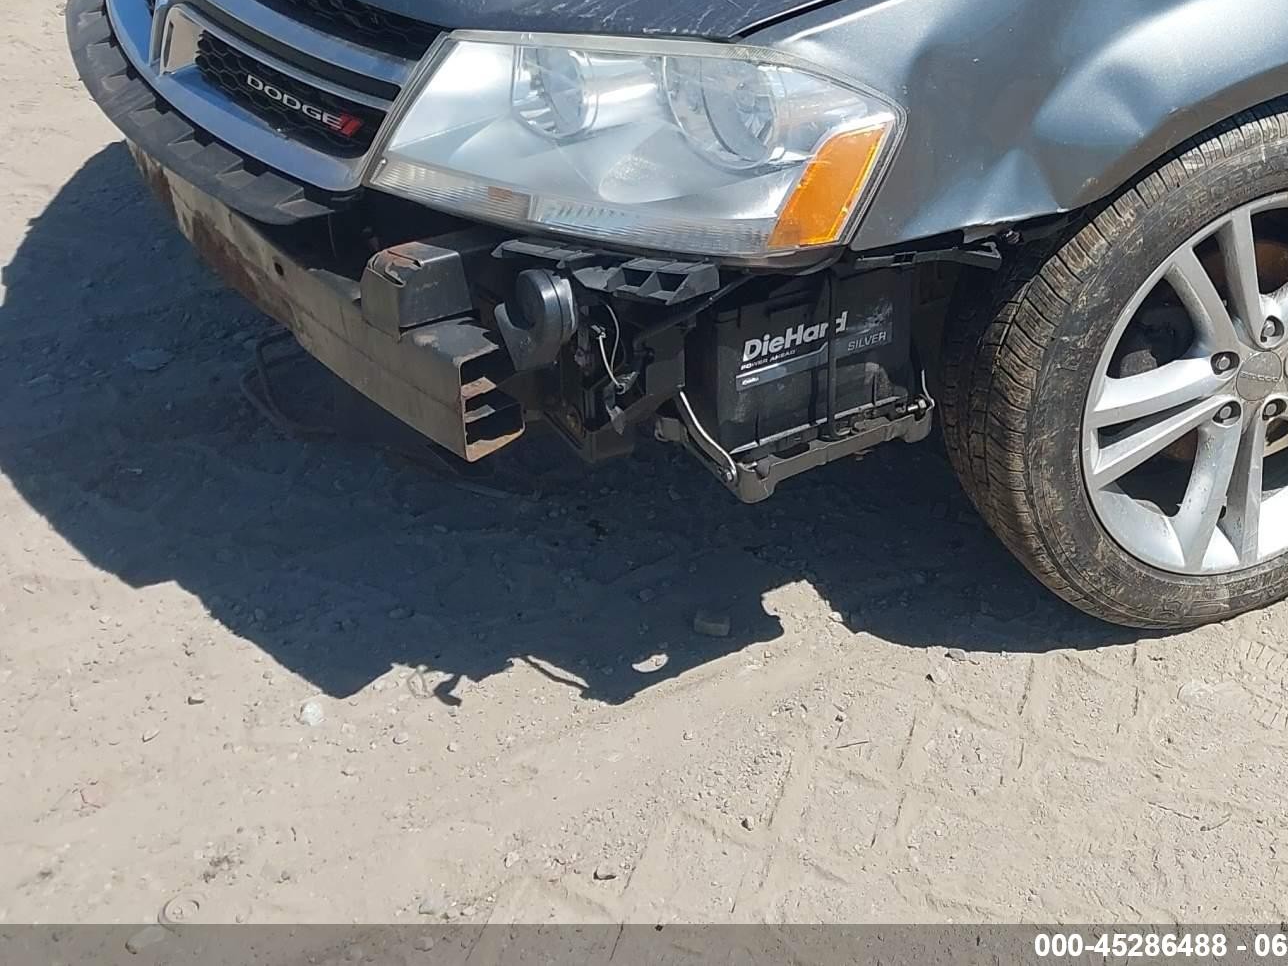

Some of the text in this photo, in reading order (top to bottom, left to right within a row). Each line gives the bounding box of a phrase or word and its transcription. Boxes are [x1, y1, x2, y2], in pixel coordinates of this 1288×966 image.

[247, 74, 342, 130] DODGE
[742, 310, 849, 362] DieHard
[847, 331, 887, 351] SILVER
